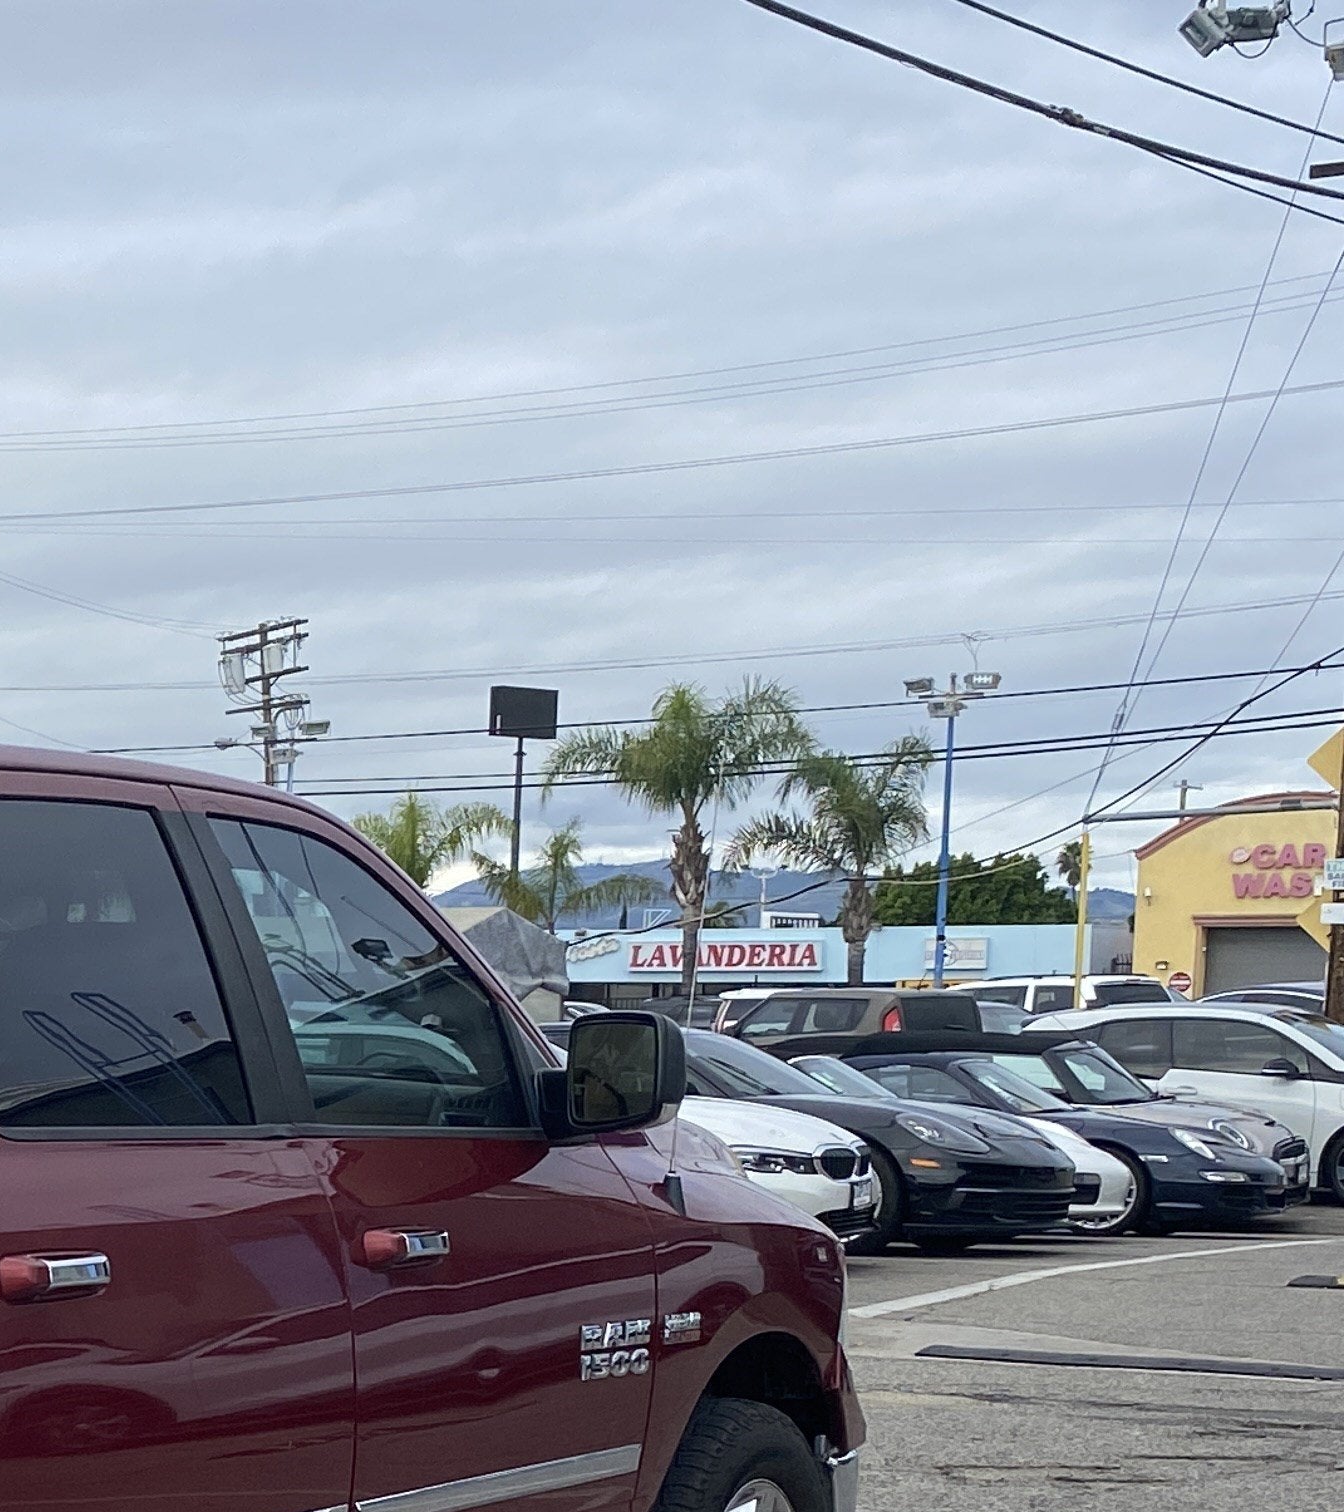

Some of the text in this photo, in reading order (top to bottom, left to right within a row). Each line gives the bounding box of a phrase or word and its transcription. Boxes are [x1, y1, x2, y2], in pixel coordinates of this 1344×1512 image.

[1251, 843, 1327, 869] CAR
[1232, 872, 1313, 899] WAS
[580, 1348, 651, 1382] 1500
